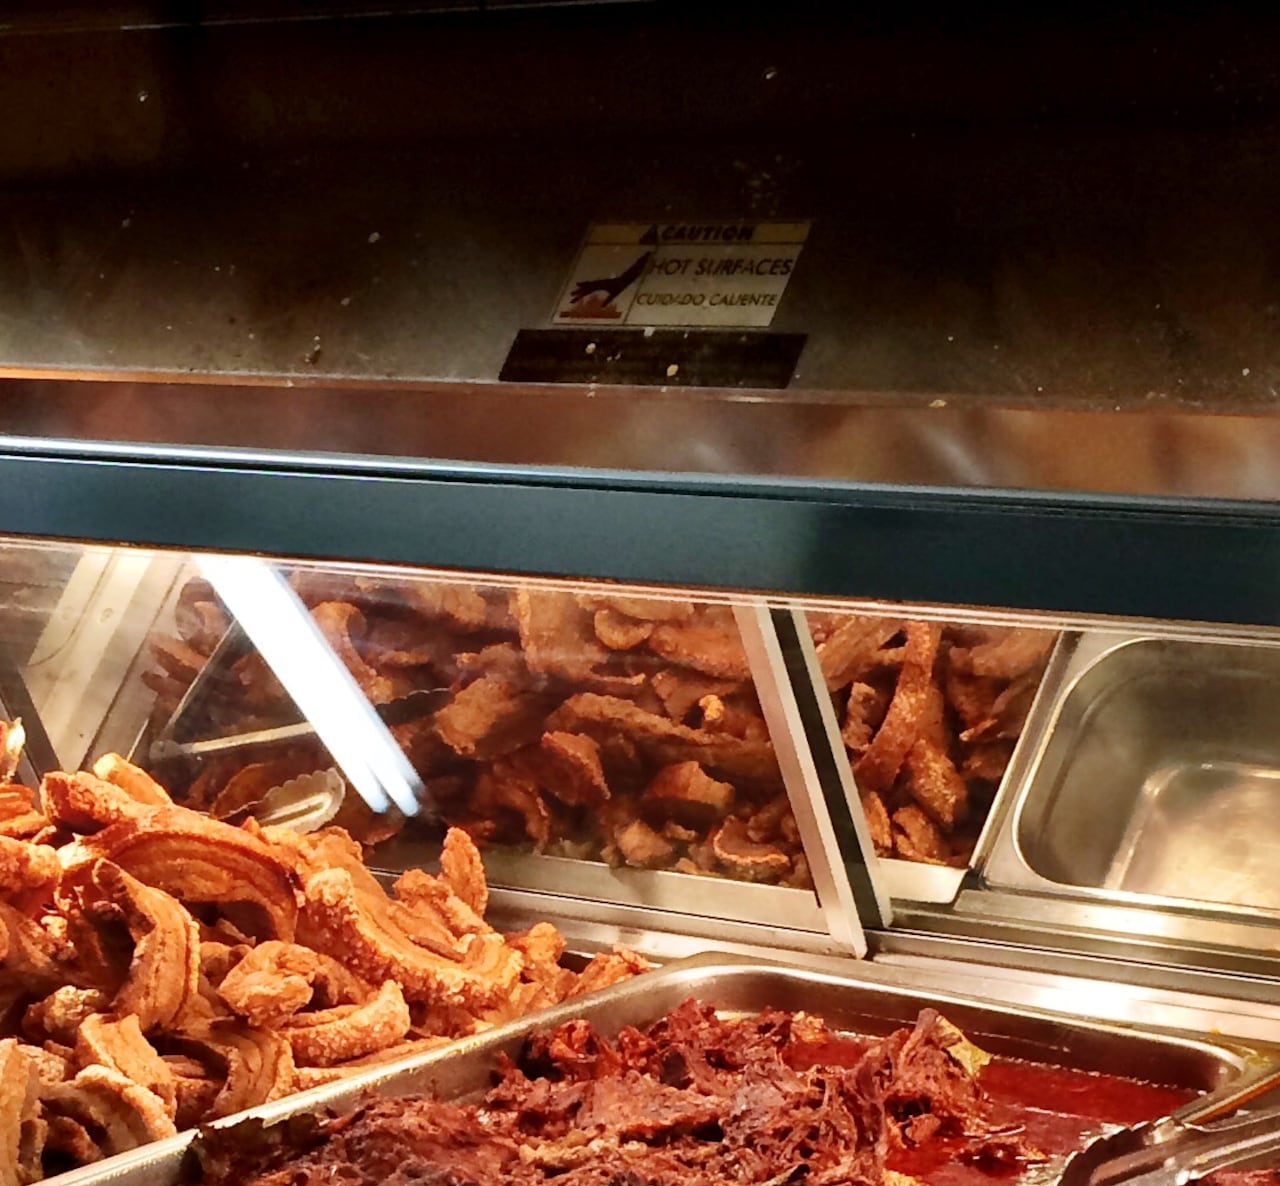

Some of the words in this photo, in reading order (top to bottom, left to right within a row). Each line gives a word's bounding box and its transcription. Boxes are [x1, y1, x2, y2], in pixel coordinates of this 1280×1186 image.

[661, 225, 755, 241] CAUTION
[650, 258, 692, 276] HOT
[694, 257, 794, 277] SURFACES
[635, 292, 705, 307] CUIDADO
[708, 293, 778, 307] CALIENTE
